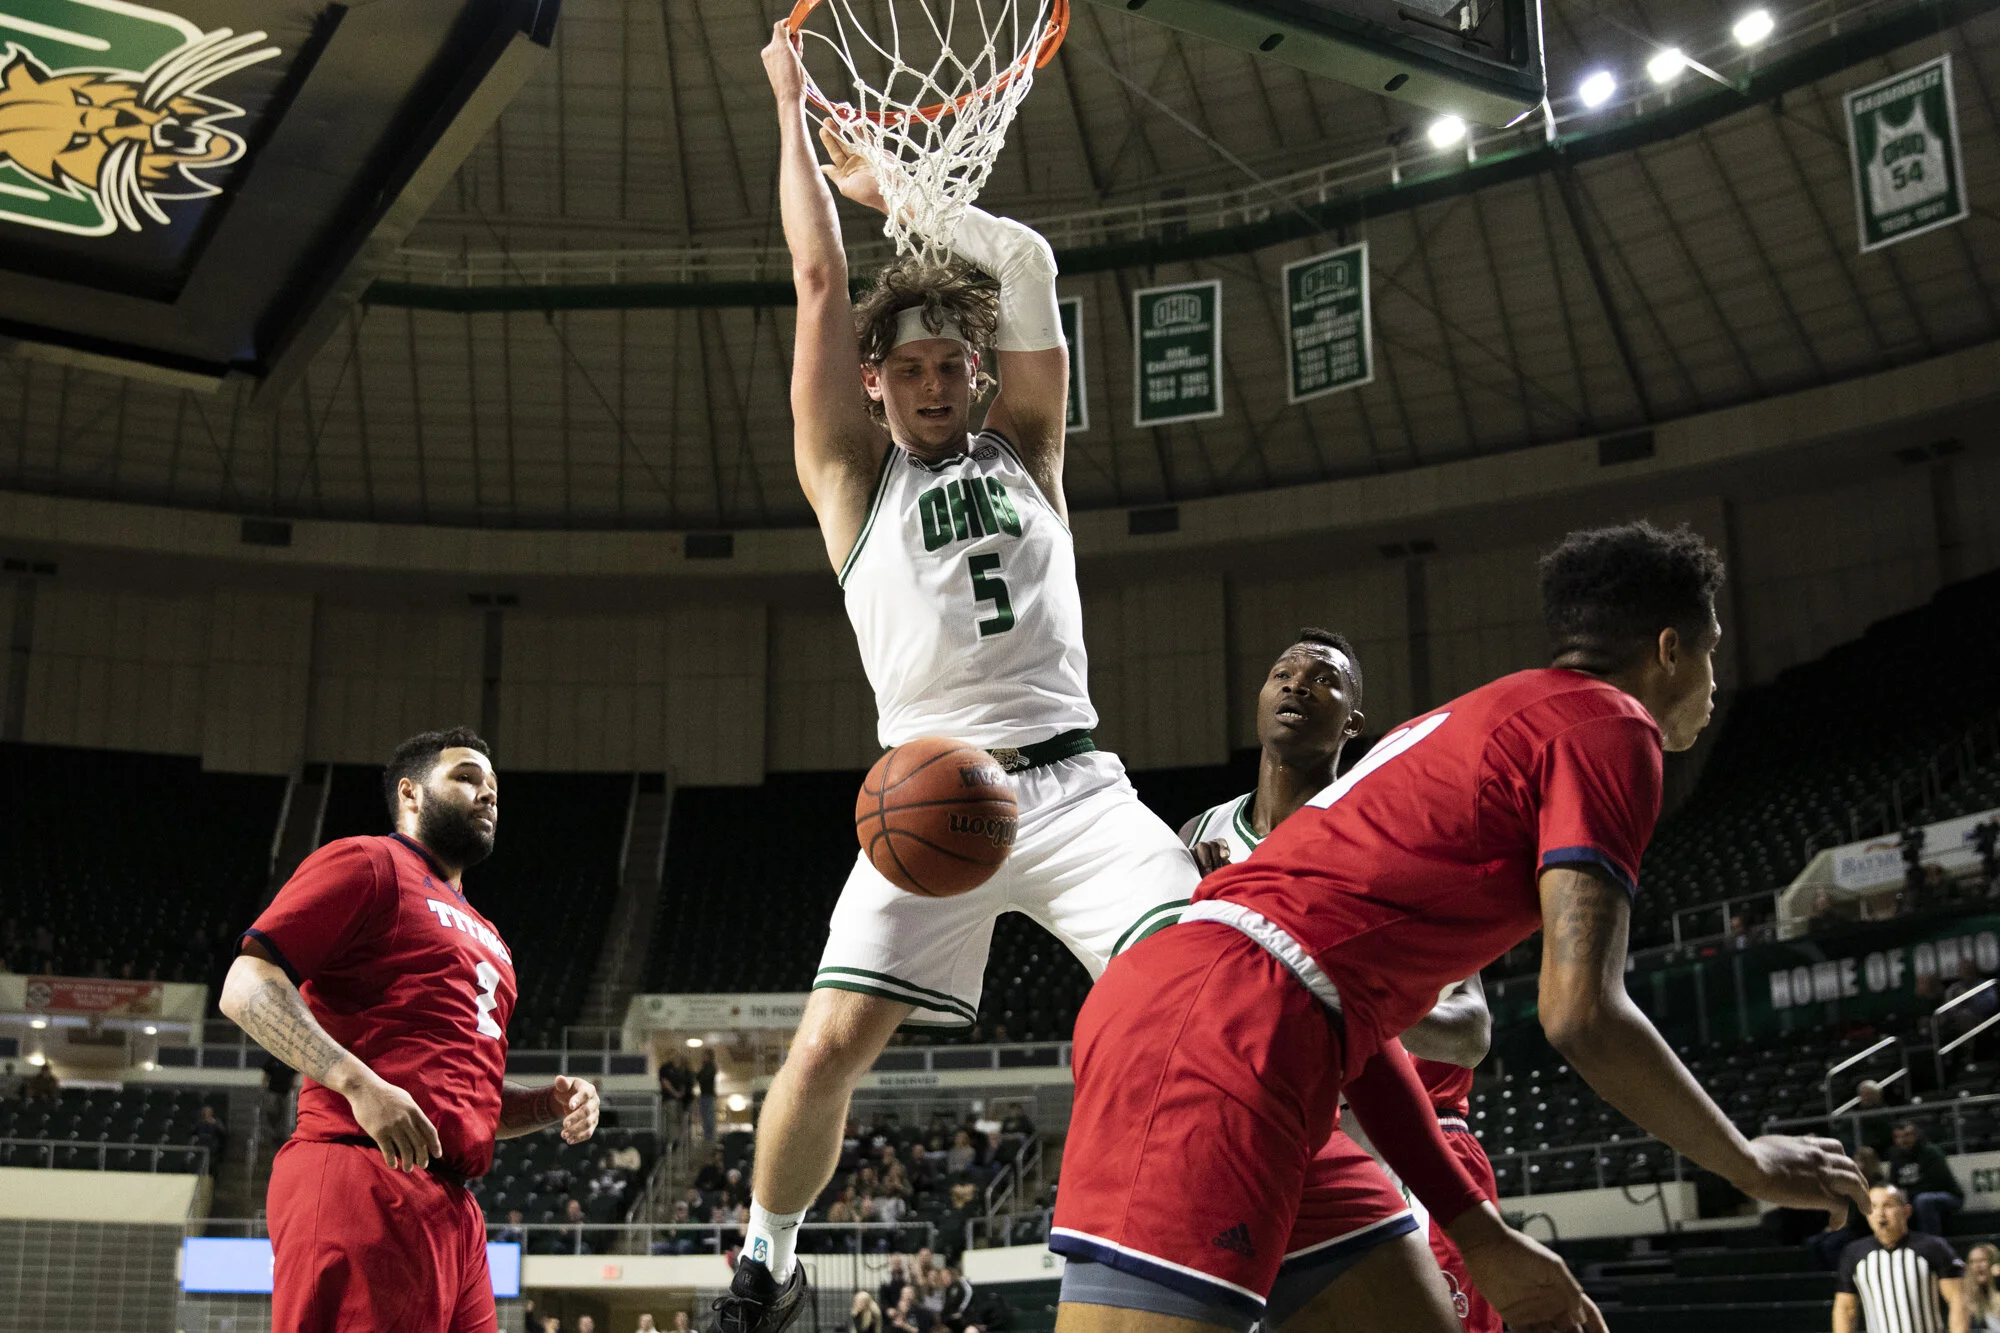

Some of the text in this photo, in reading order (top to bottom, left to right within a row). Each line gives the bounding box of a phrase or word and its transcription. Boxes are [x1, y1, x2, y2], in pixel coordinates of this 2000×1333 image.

[1892, 161, 1924, 191] 54
[1152, 293, 1202, 328] OHIO
[918, 476, 1023, 553] OHIO
[967, 551, 1016, 638] 5
[426, 898, 513, 966] TITANS
[1769, 930, 2000, 1008] HOME OF OHIO
[474, 960, 503, 1041] 2
